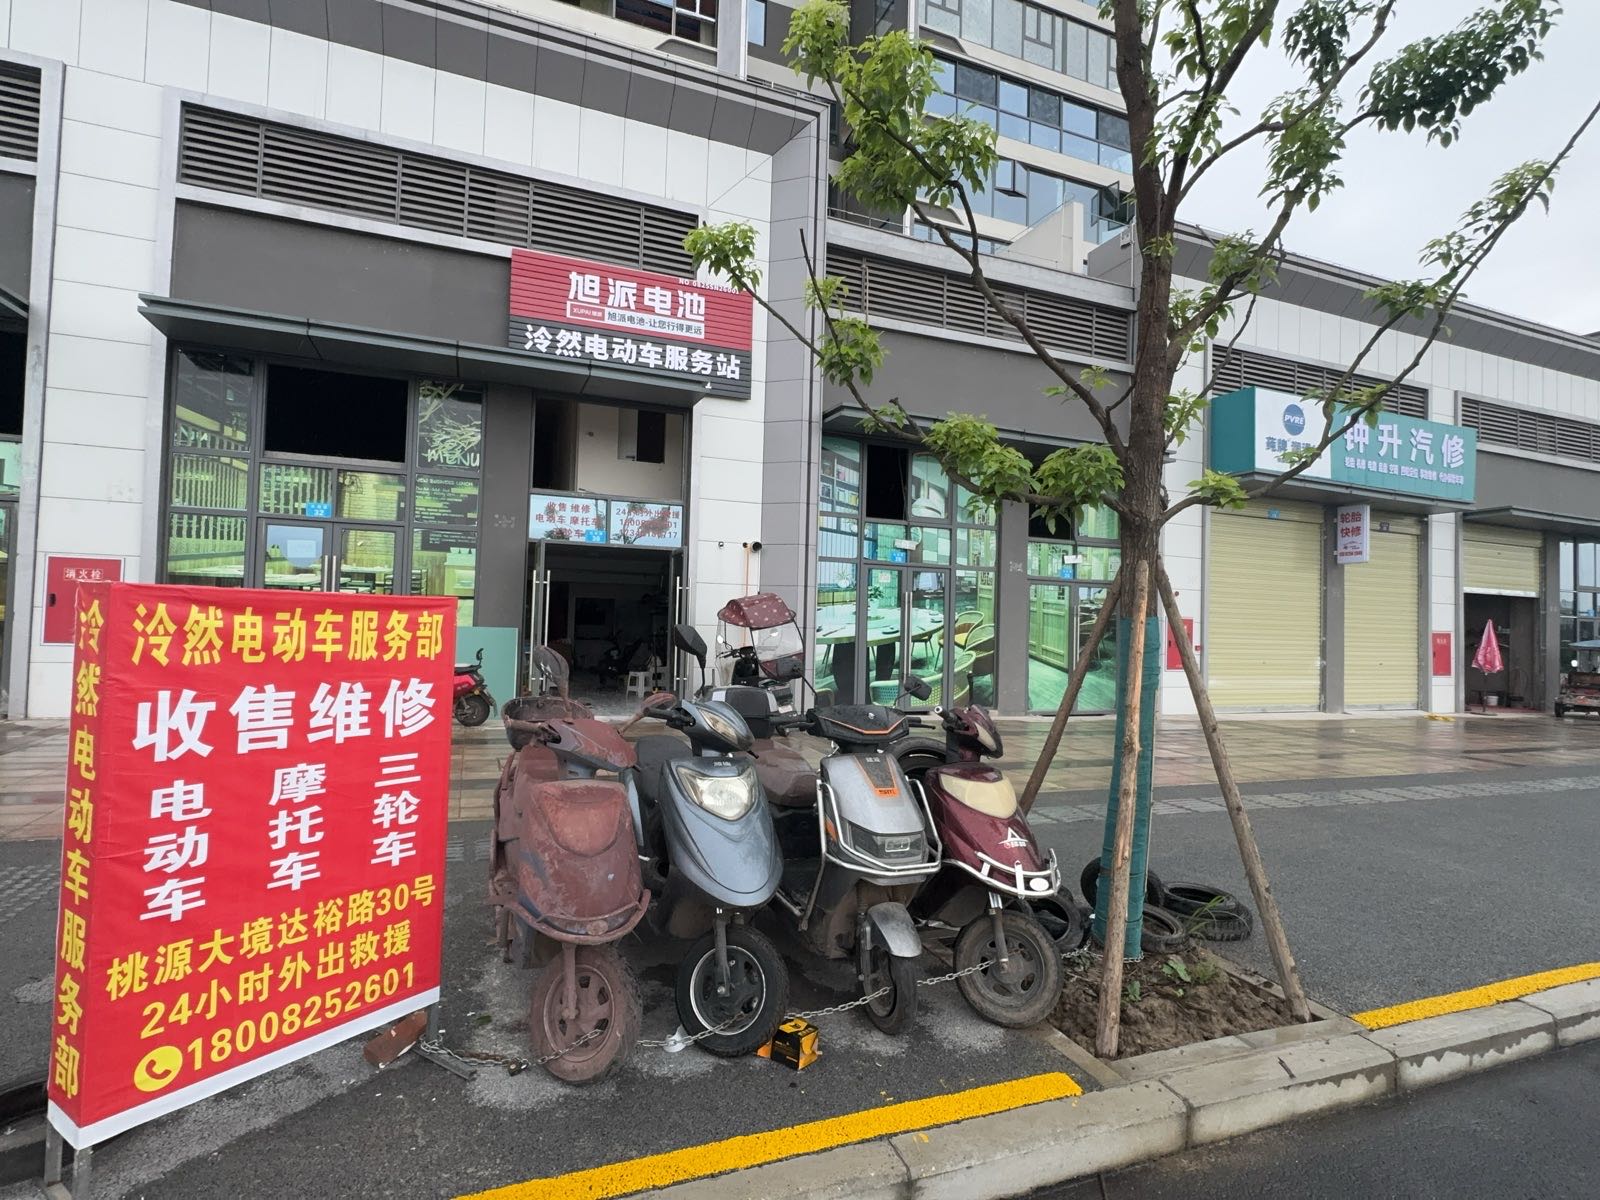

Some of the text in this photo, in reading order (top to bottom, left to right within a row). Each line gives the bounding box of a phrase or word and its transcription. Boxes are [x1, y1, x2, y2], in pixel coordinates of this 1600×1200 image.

[568, 271, 706, 321] 旭派电池
[607, 310, 703, 336] 旭派电池-让您行得更远
[524, 324, 741, 380] 泠然电动车服务站
[1343, 415, 1465, 469] 钟升汽修
[1340, 511, 1361, 524] 轮胎
[1341, 526, 1361, 538] 快修
[65, 568, 101, 579] 消火栓
[131, 602, 443, 667] 泠然电动车服务部
[132, 677, 436, 763] 收售维修
[267, 763, 326, 891] 摩托车
[371, 752, 421, 867] 三轮车
[139, 779, 212, 922] 电动车
[105, 874, 436, 1001] 桃源大境达裕路30号
[140, 919, 412, 1039] 24小时外出救援
[187, 961, 415, 1071] 18008252601
